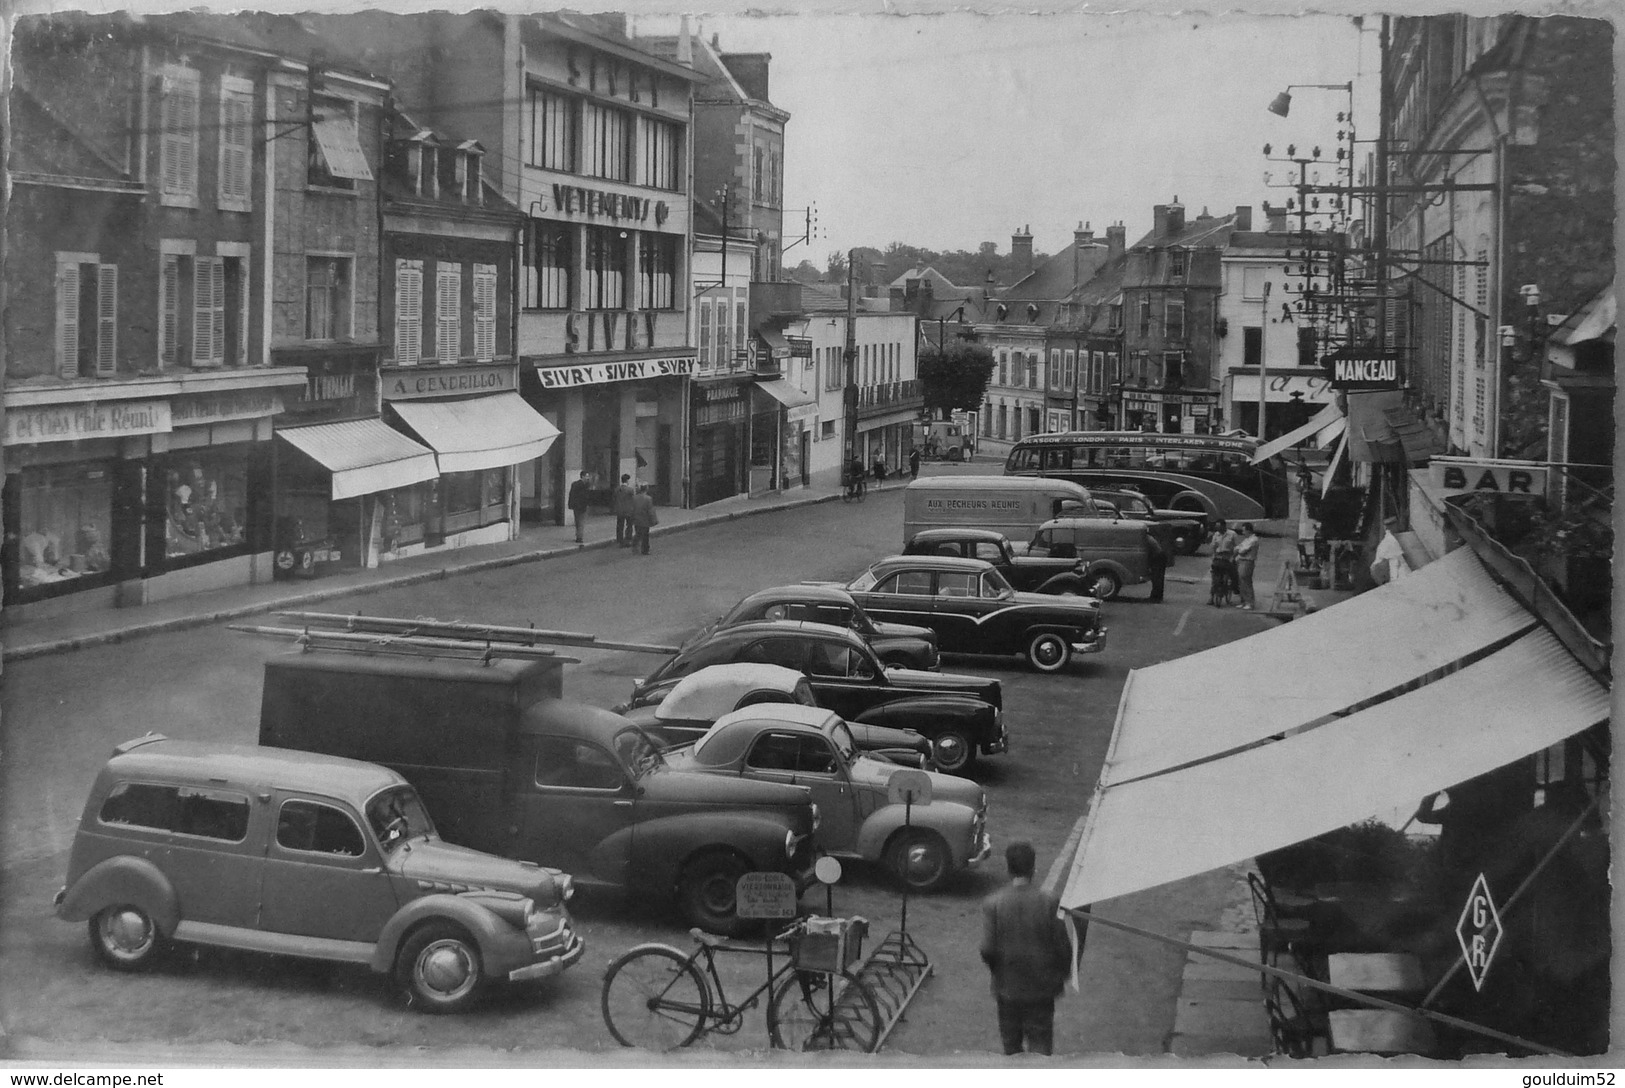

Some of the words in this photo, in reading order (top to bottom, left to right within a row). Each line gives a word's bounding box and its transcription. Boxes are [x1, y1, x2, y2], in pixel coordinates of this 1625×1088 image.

[564, 311, 658, 353] SIVRY
[541, 367, 593, 386] SIVRY
[605, 362, 645, 379] SIVRY
[657, 358, 695, 374] SIVRY
[1335, 360, 1396, 381] MANCEAU
[416, 373, 503, 393] CENDRILLON
[1156, 437, 1204, 445] INTERLAKEN
[1444, 467, 1533, 493] BAR
[928, 500, 943, 508] AUX
